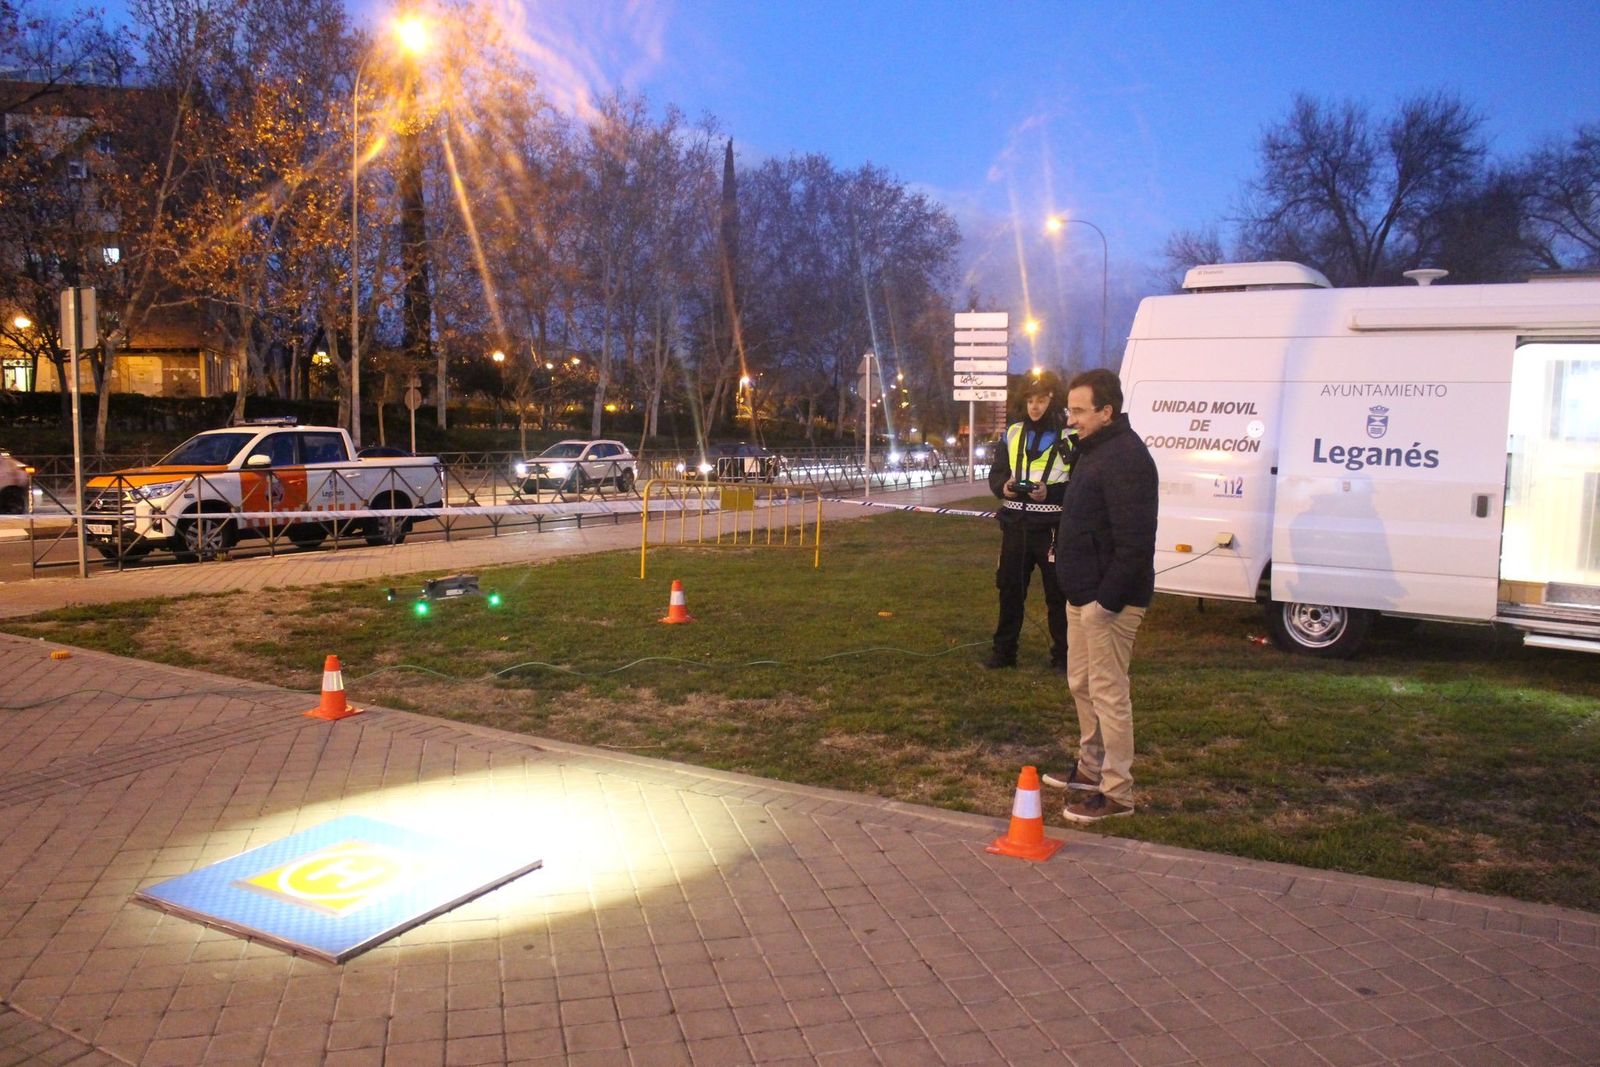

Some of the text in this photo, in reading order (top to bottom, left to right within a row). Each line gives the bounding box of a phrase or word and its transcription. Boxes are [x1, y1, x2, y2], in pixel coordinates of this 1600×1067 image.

[1320, 384, 1448, 398] AYUNTAMIENTO
[1151, 400, 1258, 415] UNIDAD MOVIL
[1189, 419, 1211, 432] DE
[1144, 435, 1261, 453] COORDINACIÓN
[1312, 438, 1440, 471] Leganés
[1223, 476, 1243, 495] 112
[308, 858, 387, 889] H
